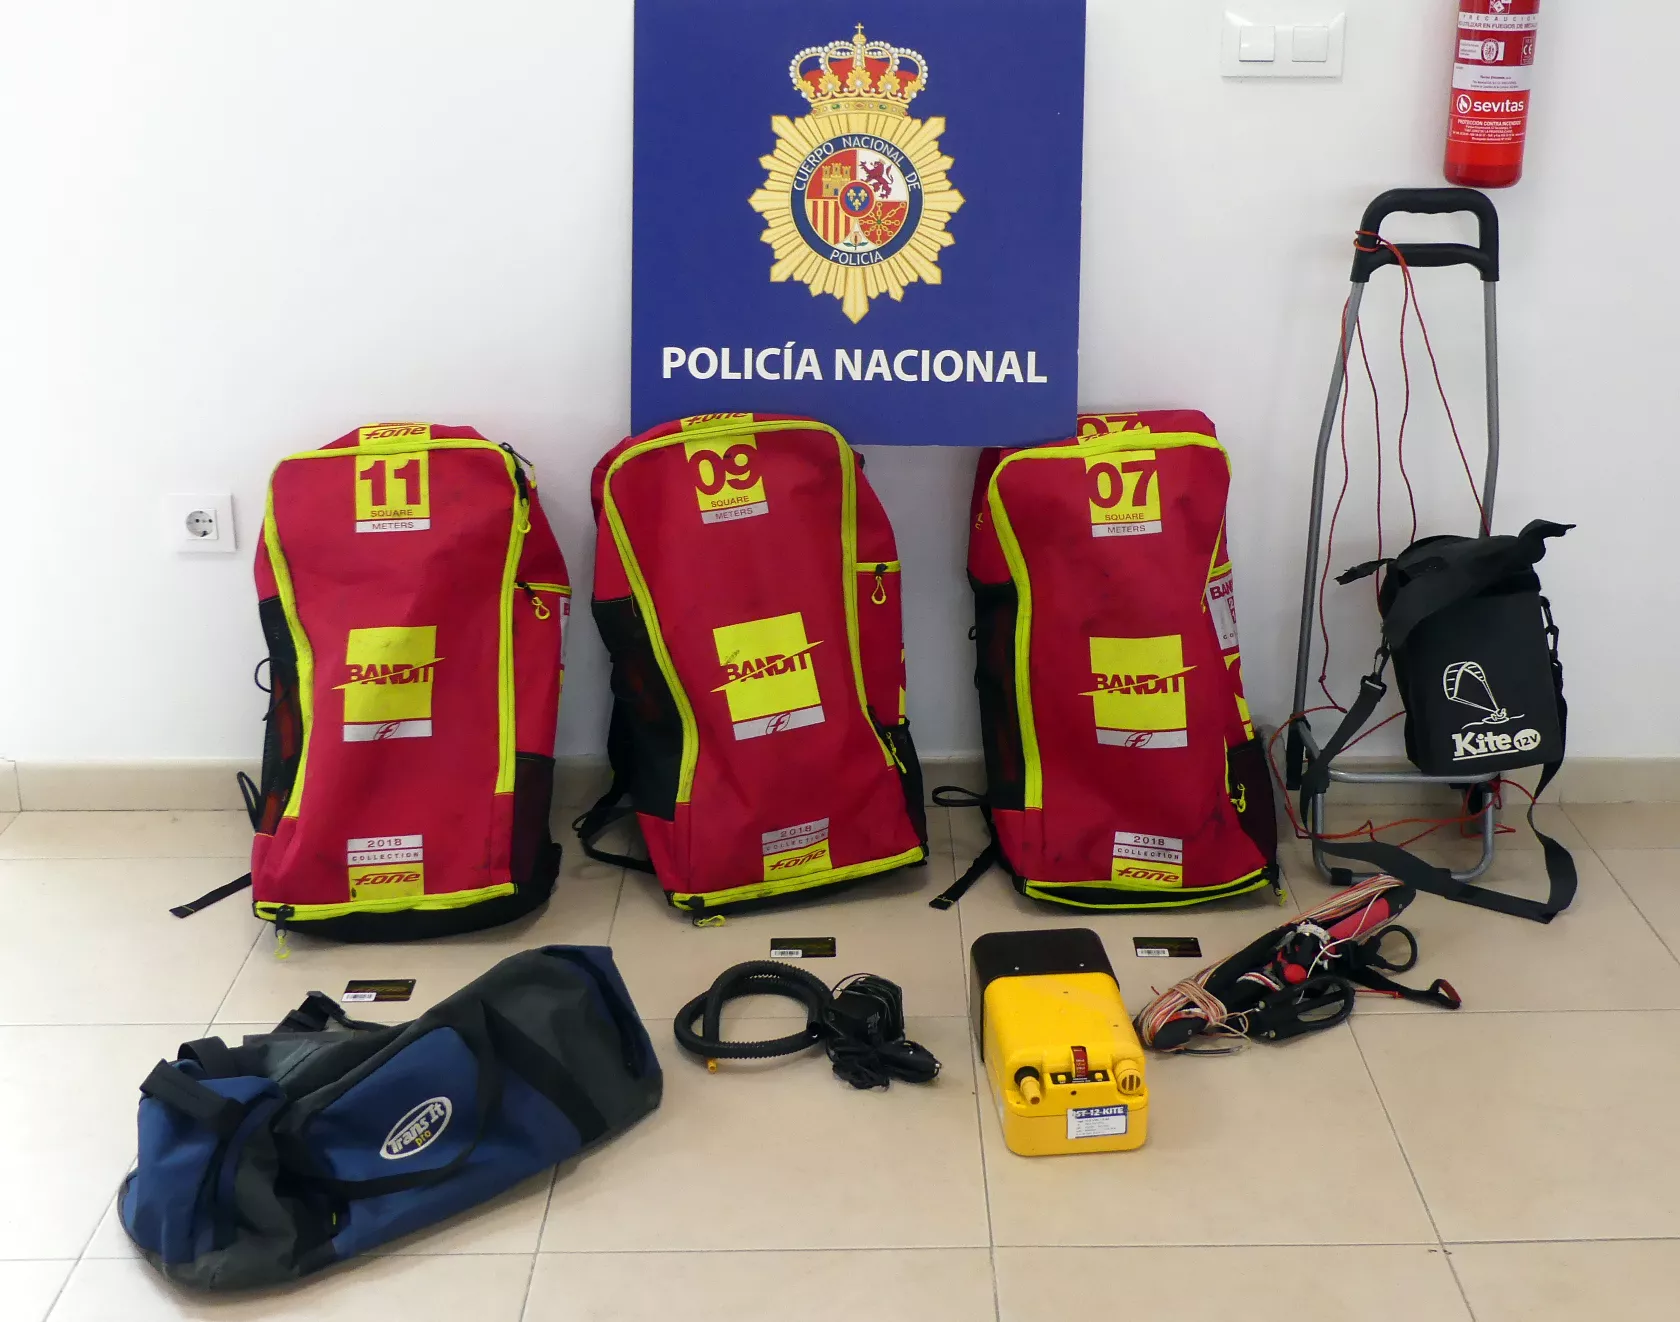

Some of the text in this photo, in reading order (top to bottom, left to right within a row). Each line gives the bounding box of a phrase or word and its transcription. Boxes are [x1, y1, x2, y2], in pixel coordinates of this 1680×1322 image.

[1473, 99, 1524, 112] sevitas
[793, 136, 921, 192] CUERPO NACIONAL DE
[830, 250, 883, 266] POLICIA
[662, 341, 1048, 384] POLICÍA NACIONAL
[689, 444, 762, 495] 09
[360, 459, 421, 506] 11
[1086, 460, 1157, 508] 07
[711, 495, 750, 508] SQUARE
[371, 509, 413, 518] SQUARE
[715, 507, 753, 520] METERS
[1105, 512, 1145, 521] SQUARE
[372, 522, 414, 530] METERS
[1107, 525, 1146, 534] METERS
[340, 659, 440, 685] BANDIT
[717, 647, 813, 684] BANDIT
[1091, 669, 1186, 695] BANDIT
[1452, 731, 1538, 757] Kite 12V
[780, 825, 813, 838] 2018
[367, 838, 402, 848] 2018
[766, 832, 826, 851] COLLECTION
[1133, 835, 1165, 846] 2018
[352, 851, 419, 861] COLLECTION
[1117, 847, 1180, 860] COLLECTION
[1073, 1106, 1124, 1117] ST-12-KITE
[414, 1129, 433, 1147] pro
